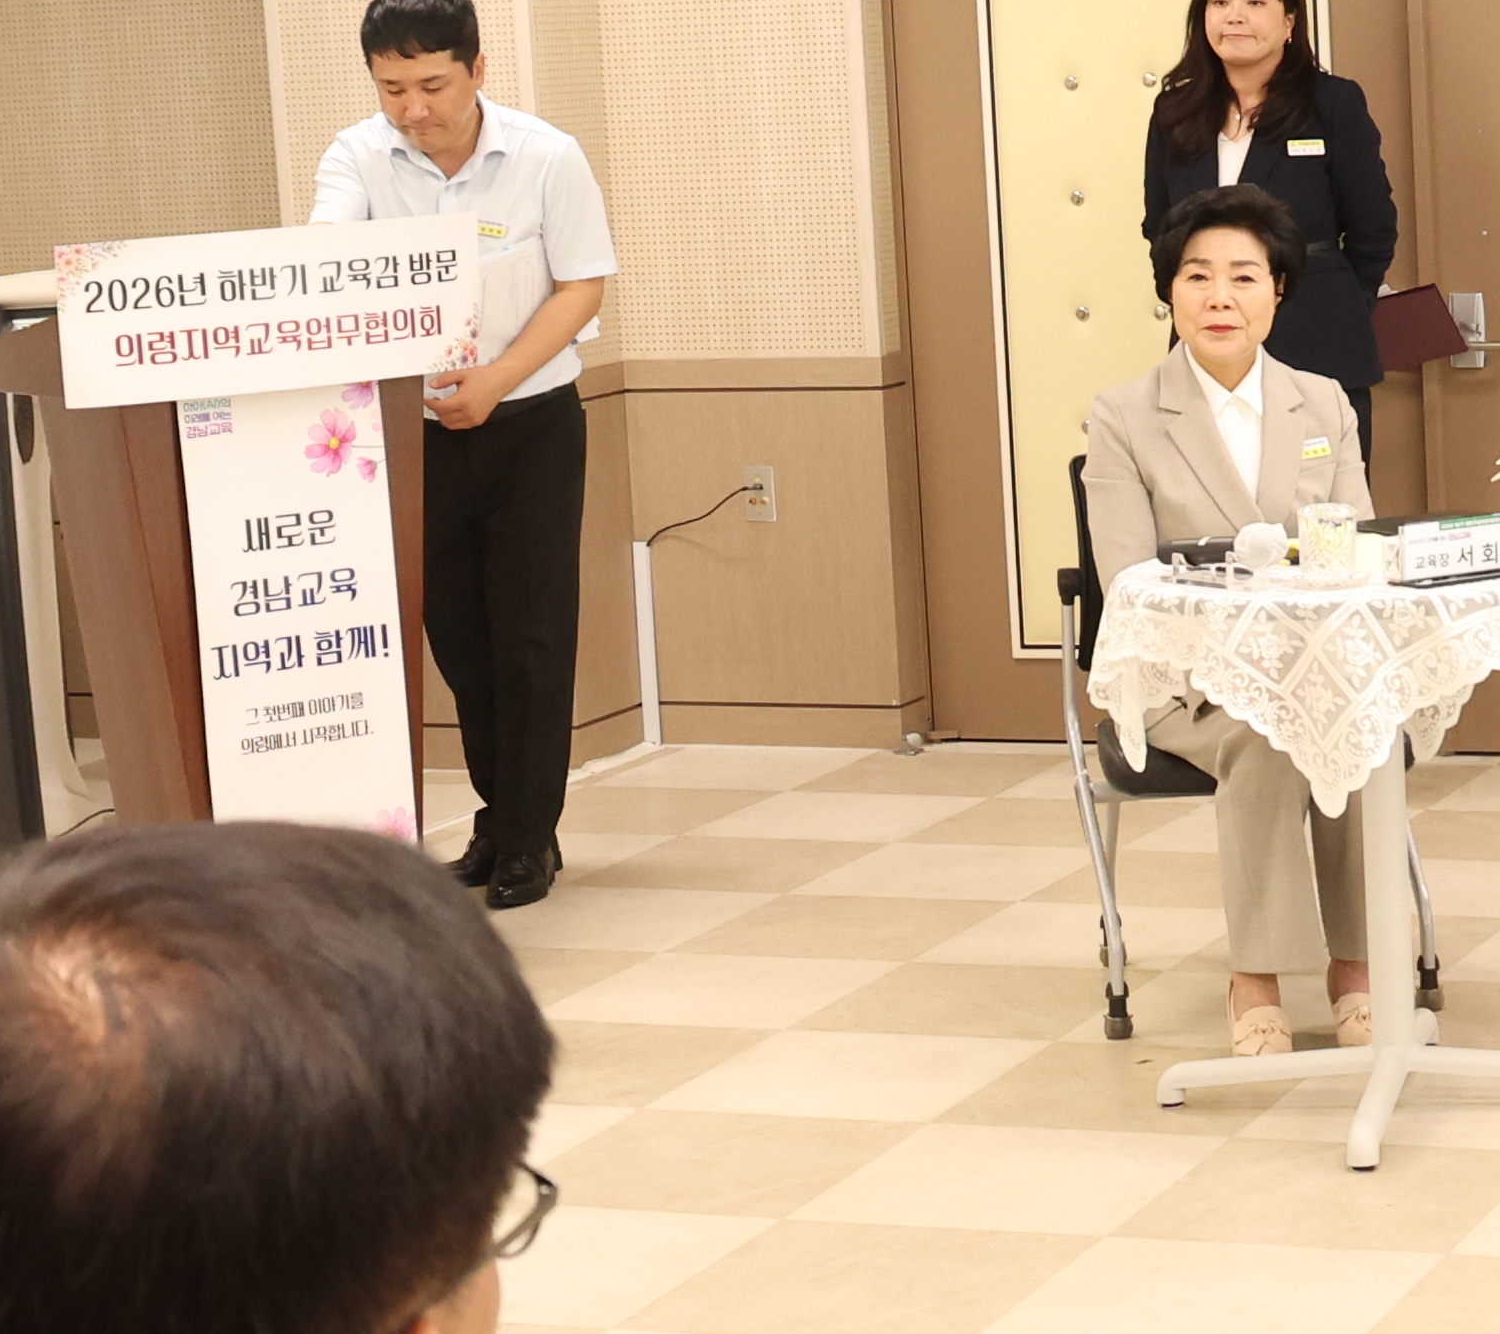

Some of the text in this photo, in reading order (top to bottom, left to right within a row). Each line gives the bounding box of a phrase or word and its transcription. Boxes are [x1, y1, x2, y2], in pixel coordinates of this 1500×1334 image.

[83, 249, 459, 314] 2026년 하반기 교육감 방문
[114, 304, 443, 367] 의령지역교육업무협의회
[185, 421, 234, 439] 경남교육
[242, 509, 336, 553] 새로운
[1415, 551, 1450, 570] 교육장
[230, 567, 358, 617] 경남교육
[210, 623, 390, 681] 지역과 함께!
[245, 692, 364, 726] 그 첫번째 이야기를
[241, 719, 375, 756] 의령에서 시작합니다.
